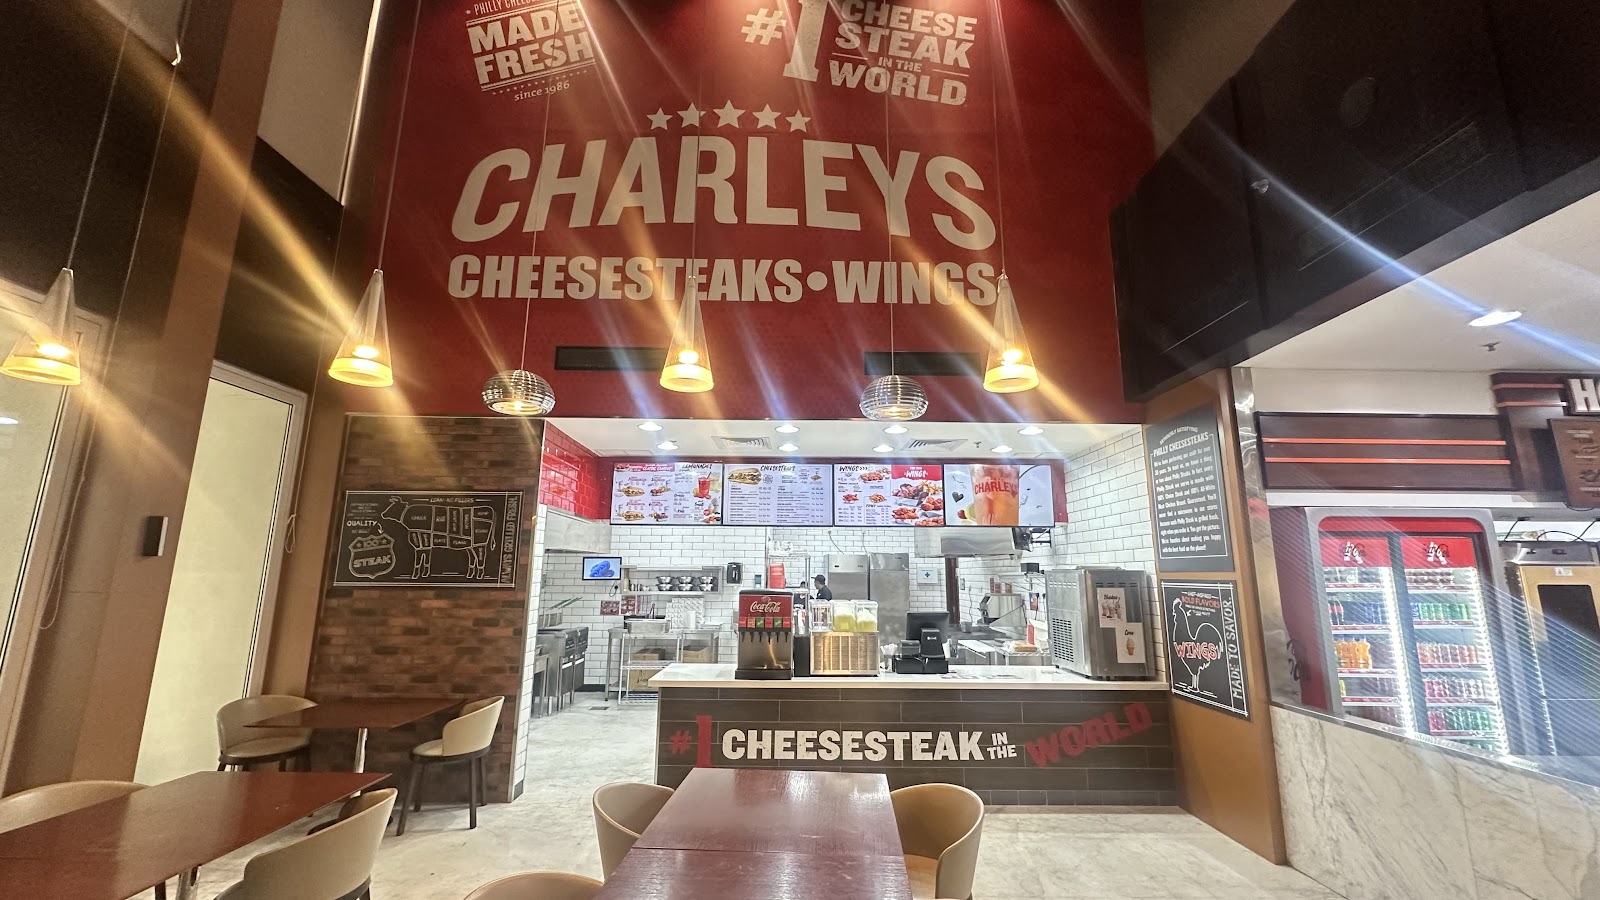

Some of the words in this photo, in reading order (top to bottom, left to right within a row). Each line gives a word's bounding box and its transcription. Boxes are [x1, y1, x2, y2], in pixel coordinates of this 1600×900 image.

[467, 5, 586, 54] MADE
[841, 1, 977, 41] CHEESE
[474, 32, 594, 84] FRESH
[835, 22, 974, 69] STEAK
[878, 56, 892, 68] IN
[896, 59, 923, 73] THE
[514, 88, 543, 101] since
[545, 80, 570, 95] 1986
[829, 59, 968, 106] WORLD
[450, 135, 997, 250] CHARLEYS
[1153, 444, 1168, 458] PHILLY
[1169, 432, 1209, 452] CHEESESTEAKS
[503, 521, 515, 553] GRILLED
[353, 554, 391, 568] STEAK
[1181, 595, 1195, 604] BOLD
[1195, 597, 1221, 609] FLAVORS
[1222, 596, 1236, 641] SAVOR.
[1173, 641, 1218, 661] WINGS
[1227, 643, 1239, 660] TO
[1230, 664, 1243, 699] MADE
[669, 714, 717, 769] #1
[722, 728, 985, 761] CHEESESTEAK
[987, 744, 1018, 760] THE
[992, 732, 1008, 746] IN
[1023, 702, 1153, 769] WORLD
